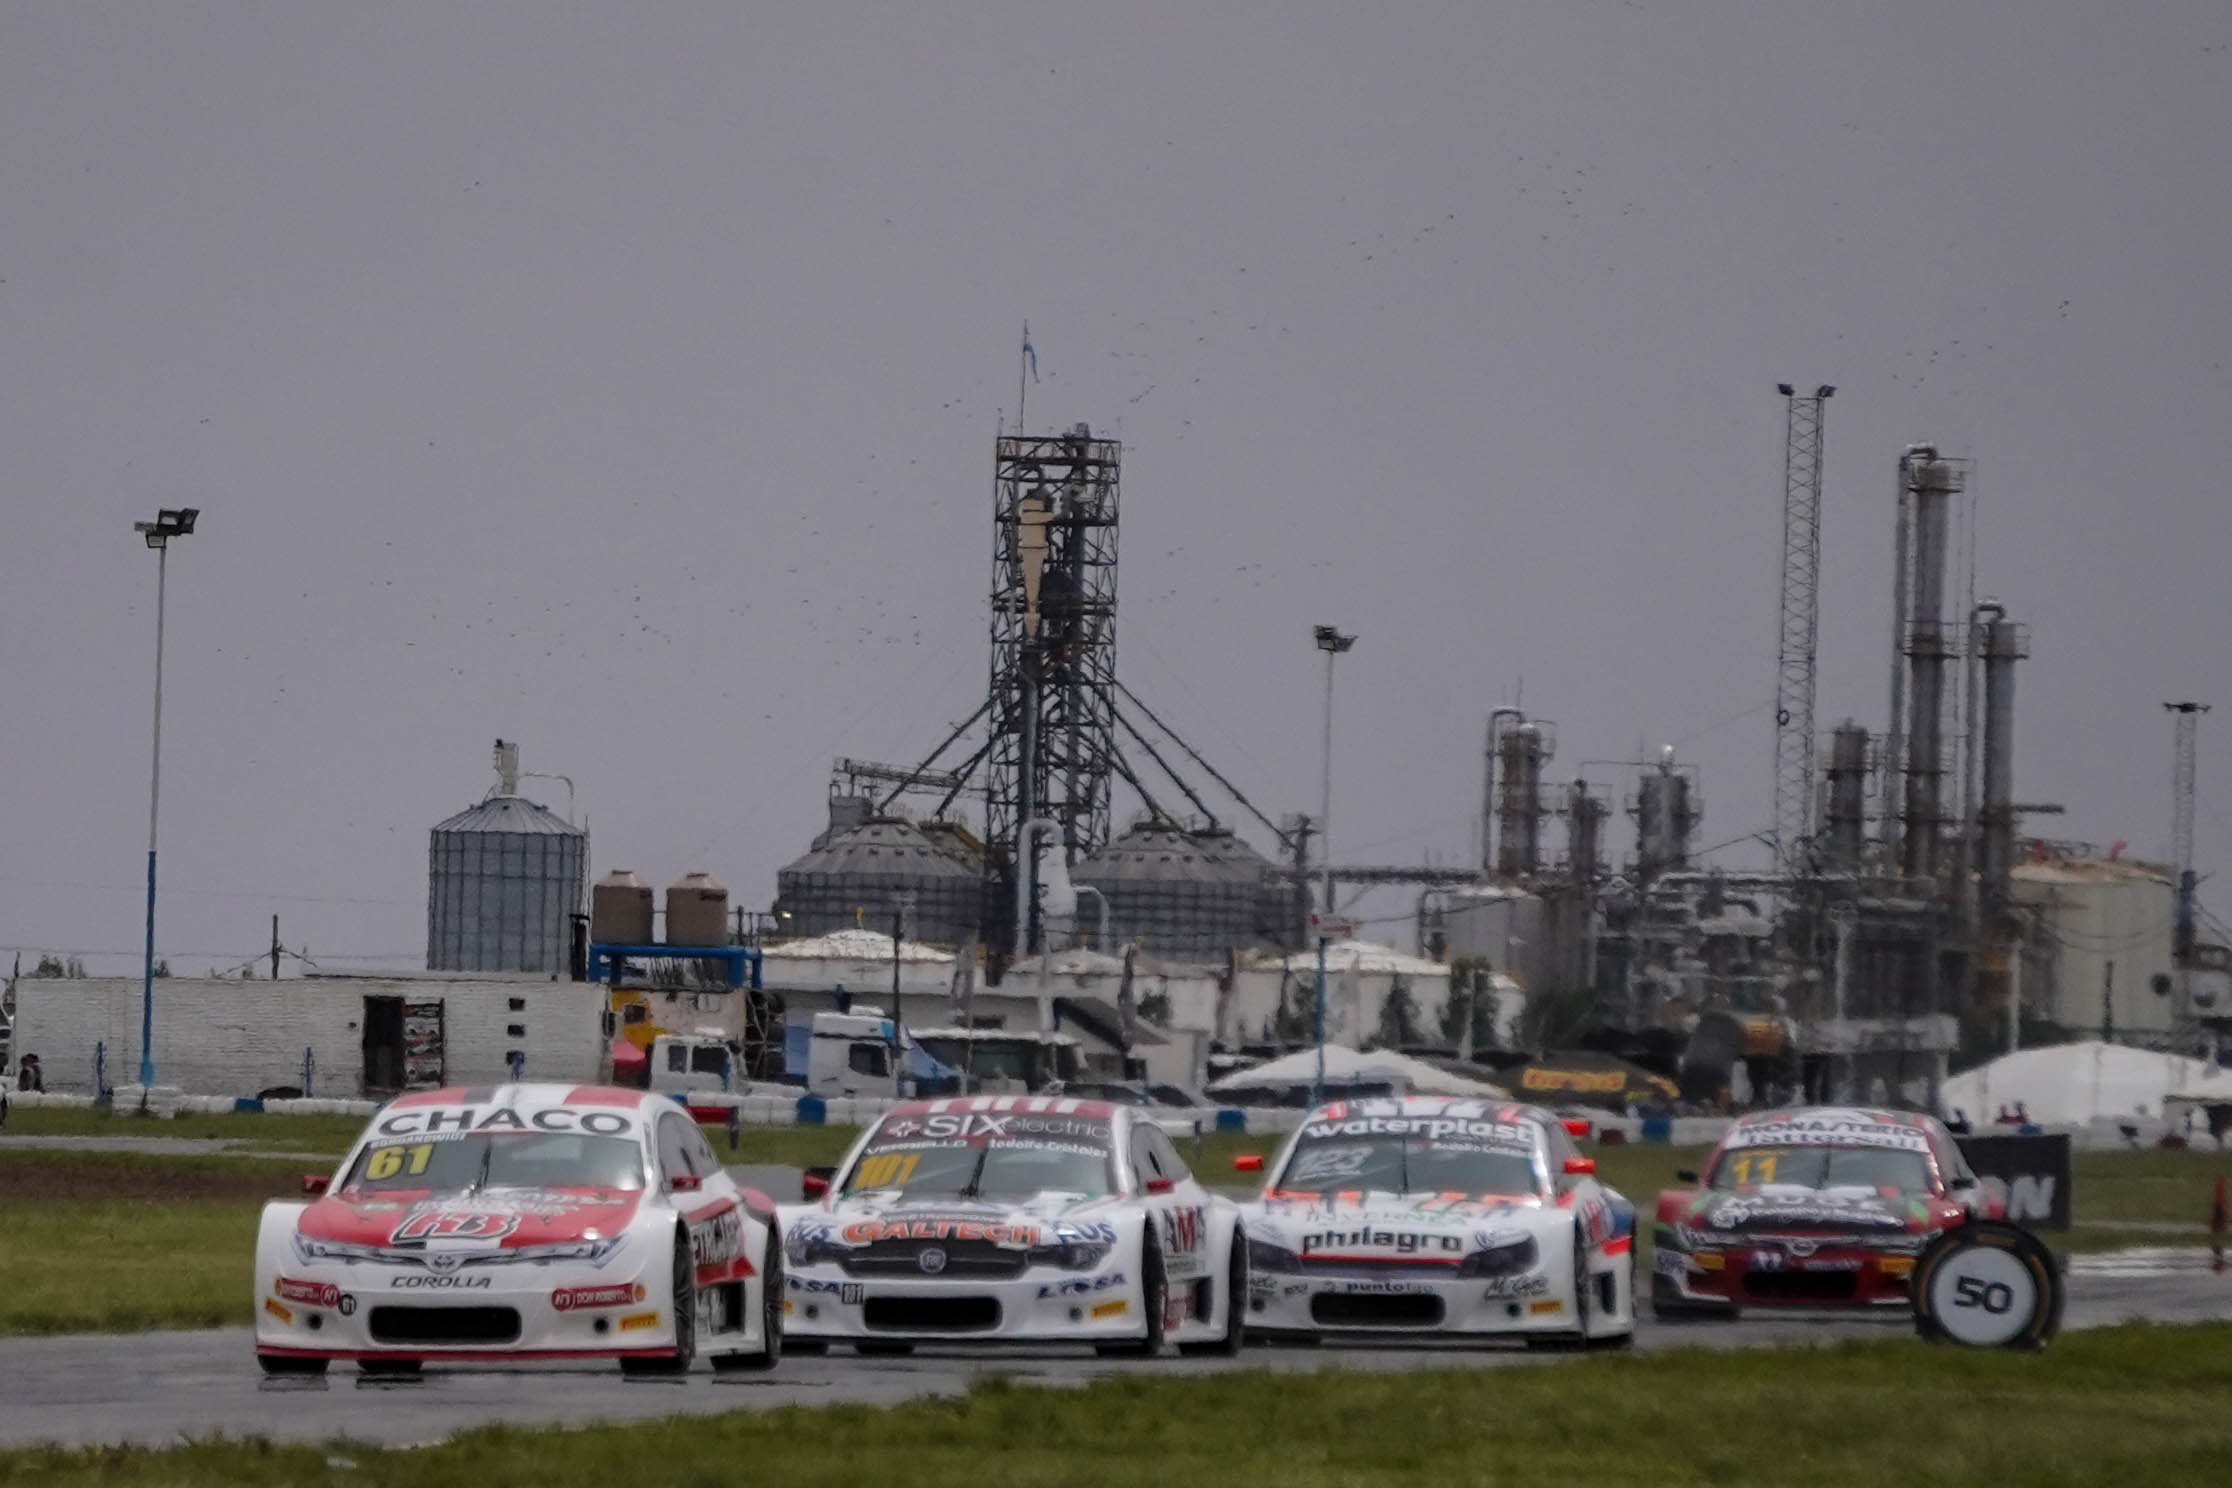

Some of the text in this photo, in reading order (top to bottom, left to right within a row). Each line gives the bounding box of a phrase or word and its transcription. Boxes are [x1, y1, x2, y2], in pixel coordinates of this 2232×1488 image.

[378, 1108, 632, 1136] CHACO
[1304, 1118, 1534, 1142] waterplast
[366, 1144, 434, 1179] 61
[853, 1153, 920, 1190] 101
[1731, 1156, 1778, 1184] 11
[842, 1219, 1039, 1245] GALTECH
[1303, 1226, 1463, 1254] philagro
[390, 1275, 493, 1290] COROLLA
[1954, 1275, 2014, 1313] 50
